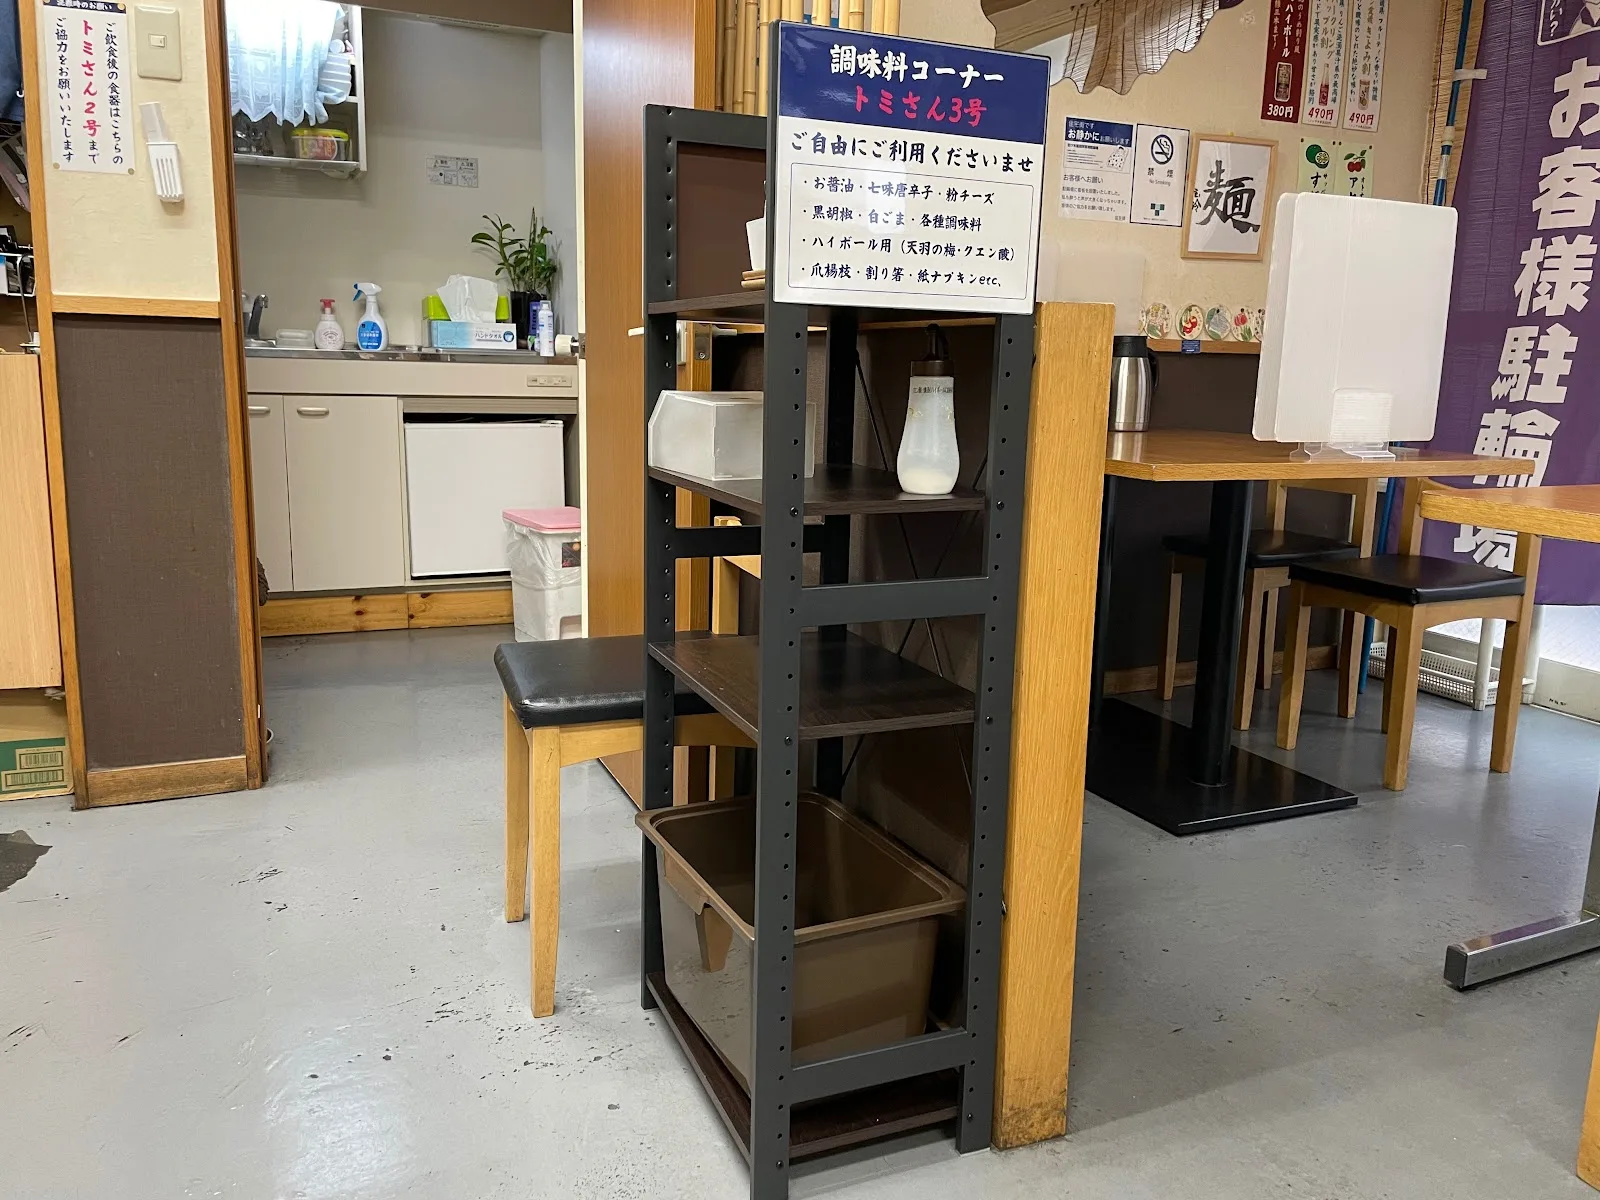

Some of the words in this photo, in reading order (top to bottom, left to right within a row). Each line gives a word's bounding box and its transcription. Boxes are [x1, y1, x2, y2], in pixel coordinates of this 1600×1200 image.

[1281, 0, 1294, 57] ハイボール
[1320, 0, 1331, 49] ップル割
[829, 43, 1005, 89] 調味料コーナー
[55, 17, 75, 163] ご協力をお願いいたします
[104, 22, 124, 165] ご飲食後の食器はこちらの
[856, 85, 988, 127] トミさん3号
[1266, 103, 1294, 119] 380円
[1308, 107, 1334, 121] 490円
[1349, 112, 1375, 126] 490円
[791, 131, 1034, 173] ご自由にご利用くださいませ
[1063, 174, 1104, 184] お客様へお願い
[1147, 167, 1174, 178] 禁煙
[1155, 179, 1171, 187] Smoking
[1310, 171, 1322, 193] す
